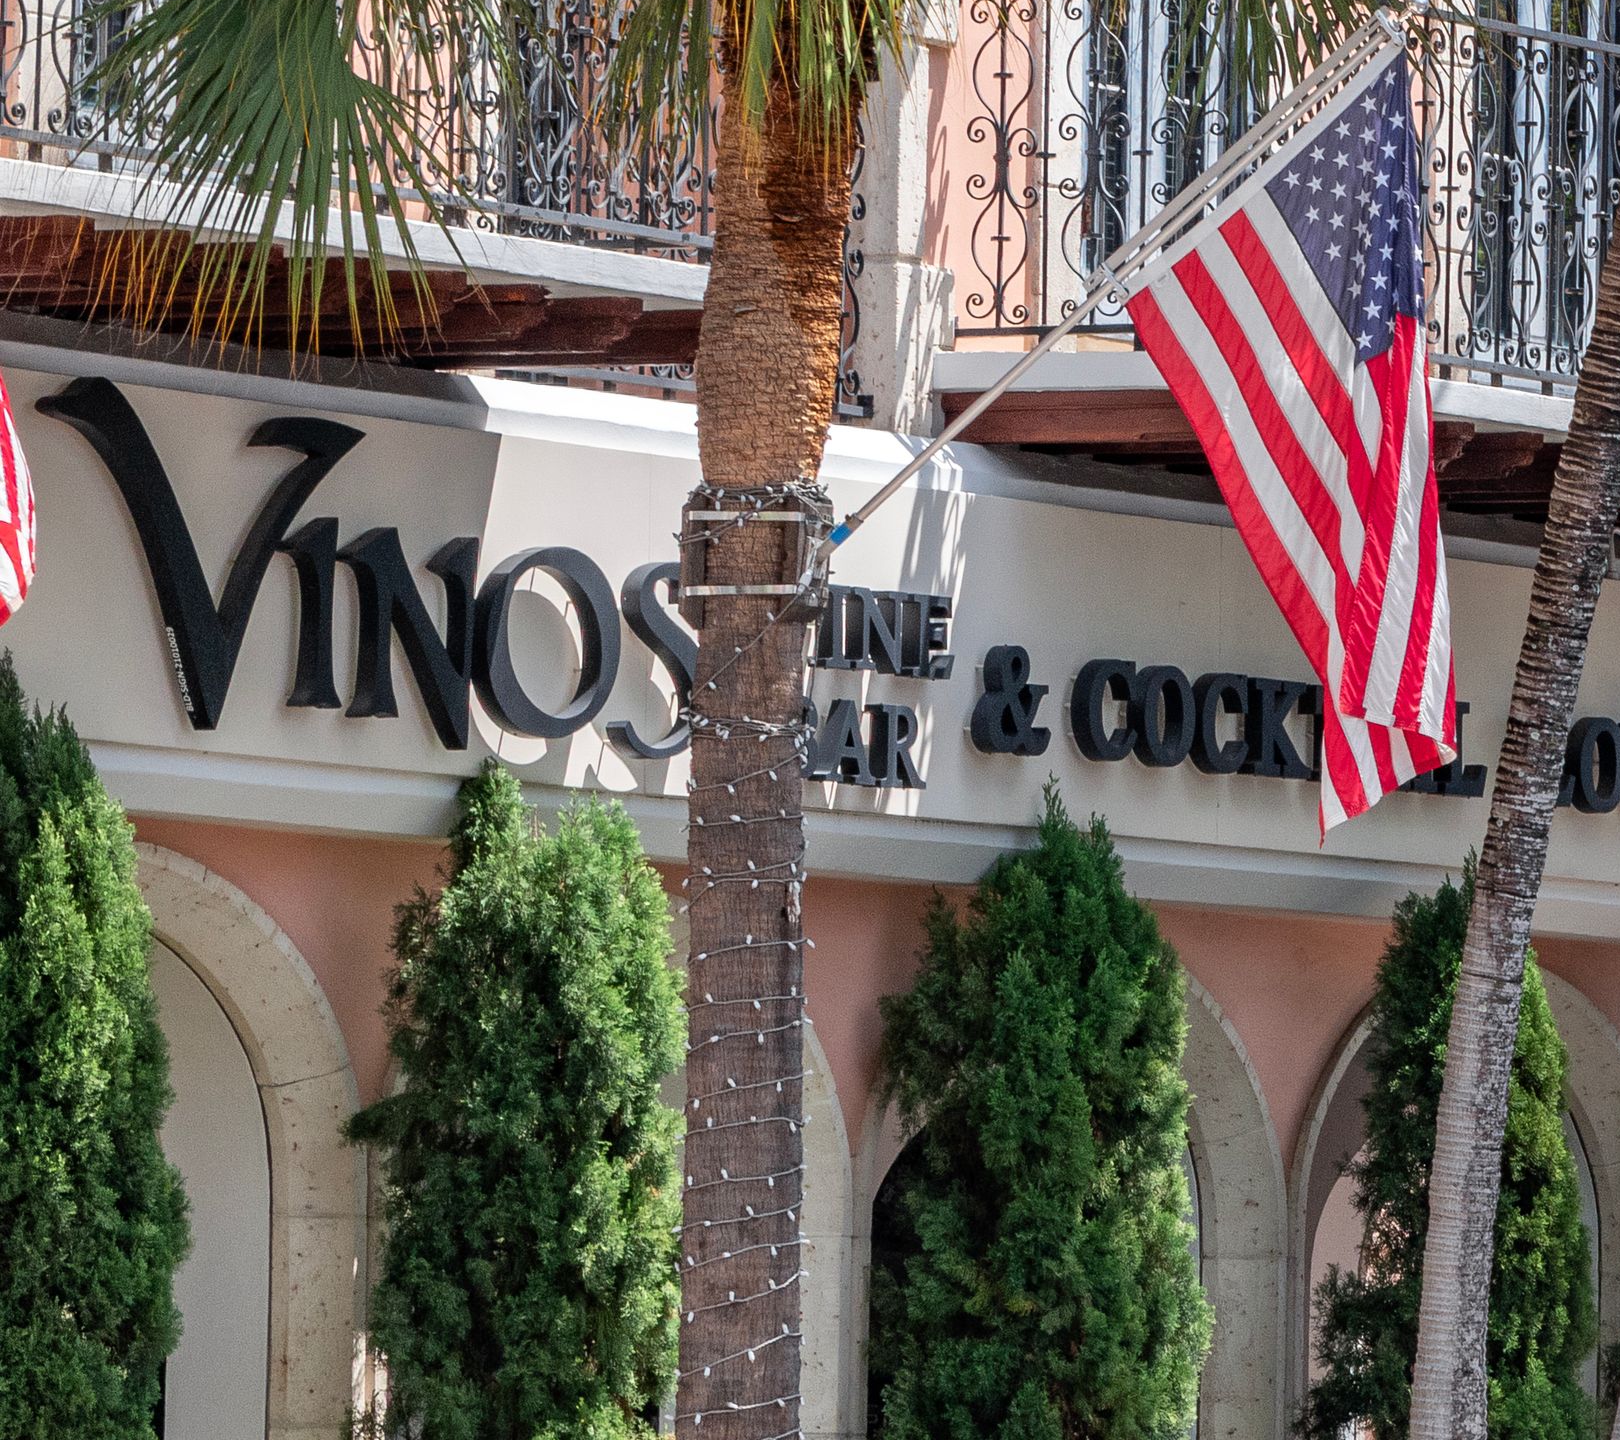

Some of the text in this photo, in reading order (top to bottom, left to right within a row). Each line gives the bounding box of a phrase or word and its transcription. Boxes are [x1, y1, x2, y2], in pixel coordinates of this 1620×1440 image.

[35, 376, 694, 759] VINOS
[808, 584, 955, 680] INE
[971, 644, 1051, 756] &
[1070, 658, 1488, 798] COCKL
